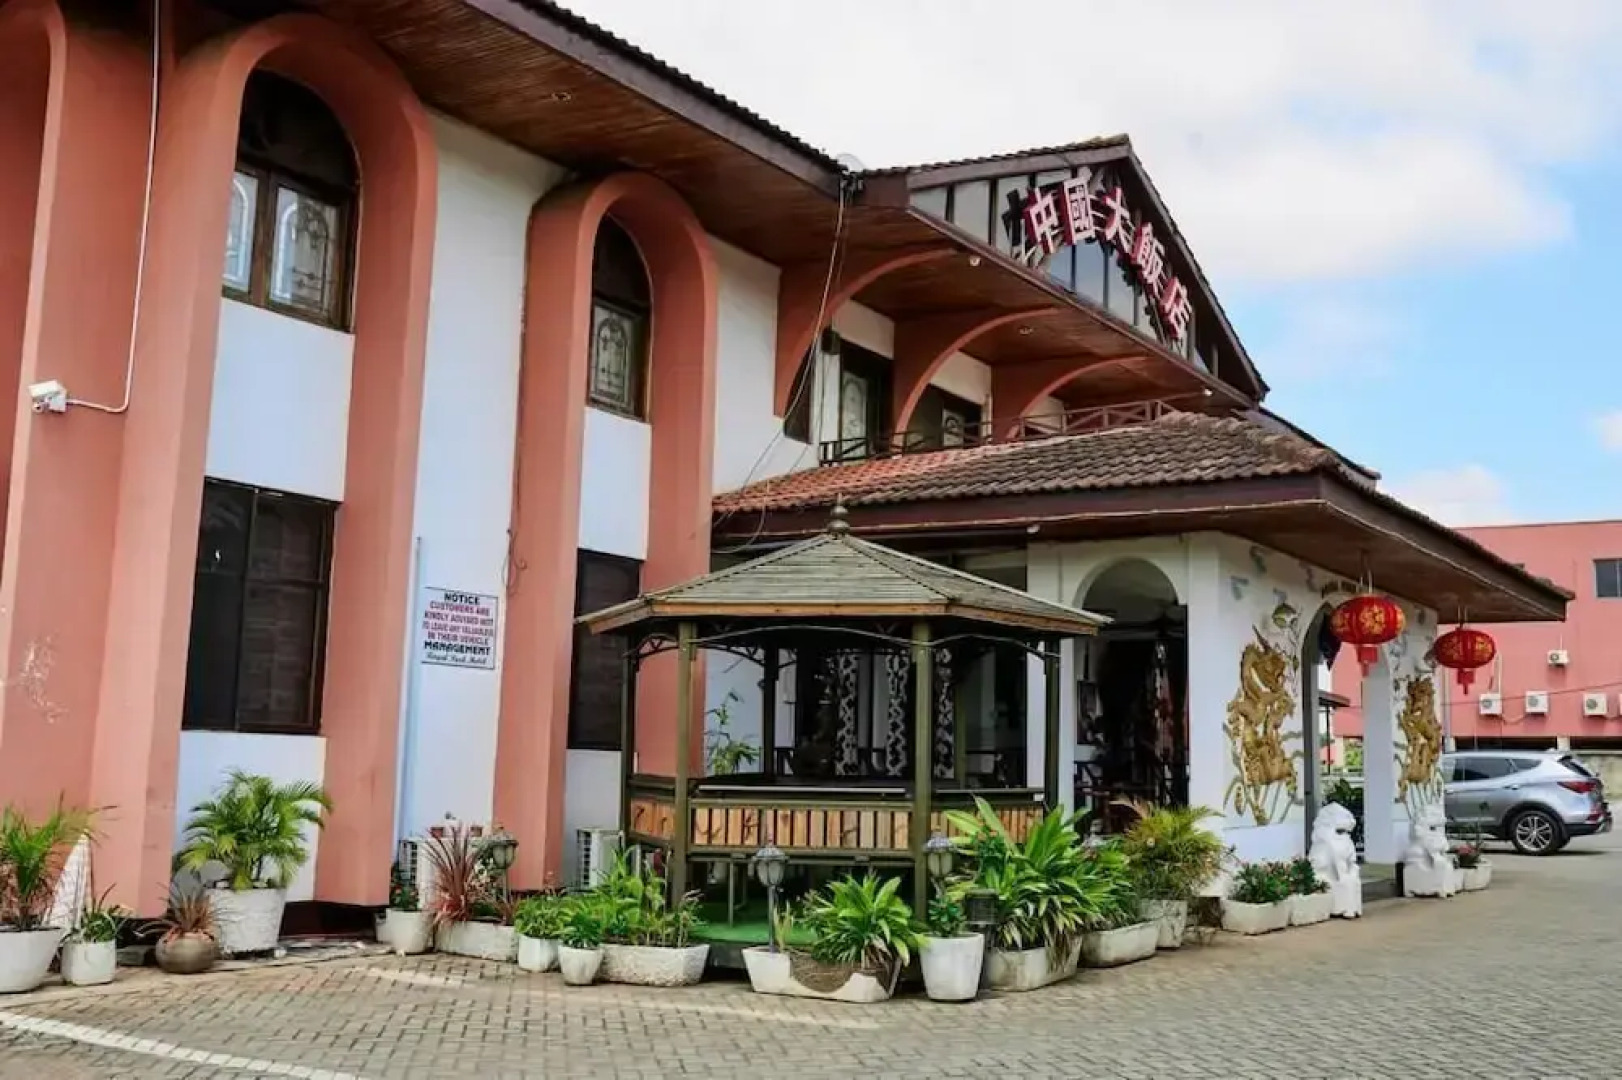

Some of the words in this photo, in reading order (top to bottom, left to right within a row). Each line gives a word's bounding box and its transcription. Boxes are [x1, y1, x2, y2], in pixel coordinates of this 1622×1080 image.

[444, 593, 480, 605] NOTICE
[430, 601, 475, 614] CUSTOMERS
[476, 607, 490, 617] ARE
[424, 610, 449, 621] KINDLY
[450, 614, 479, 625] ADVISED
[431, 622, 448, 632] LEAVE
[437, 632, 458, 642] THEIR
[424, 641, 490, 656] MANAGEMENT
